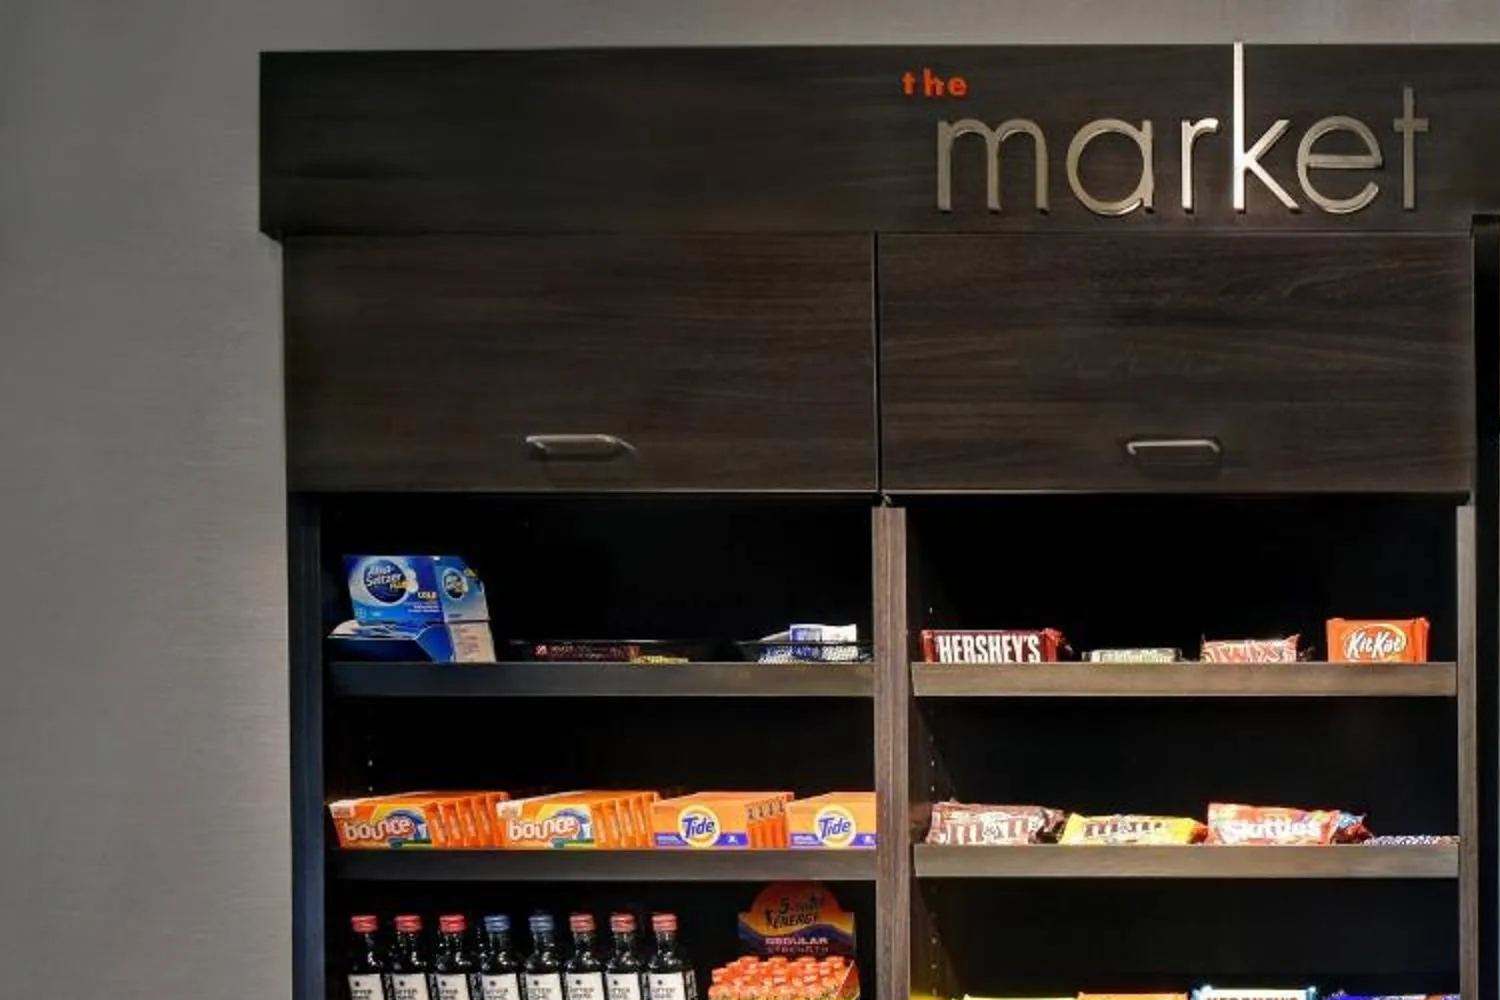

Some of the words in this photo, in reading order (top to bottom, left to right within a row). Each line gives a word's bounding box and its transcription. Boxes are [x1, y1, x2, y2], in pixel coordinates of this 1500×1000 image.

[902, 68, 968, 97] the
[936, 41, 1431, 216] market
[937, 634, 1042, 664] HERSHEY'S
[342, 816, 415, 842] bounce
[509, 815, 580, 842] bounce
[681, 814, 716, 838] Tide
[817, 814, 852, 838] Tide
